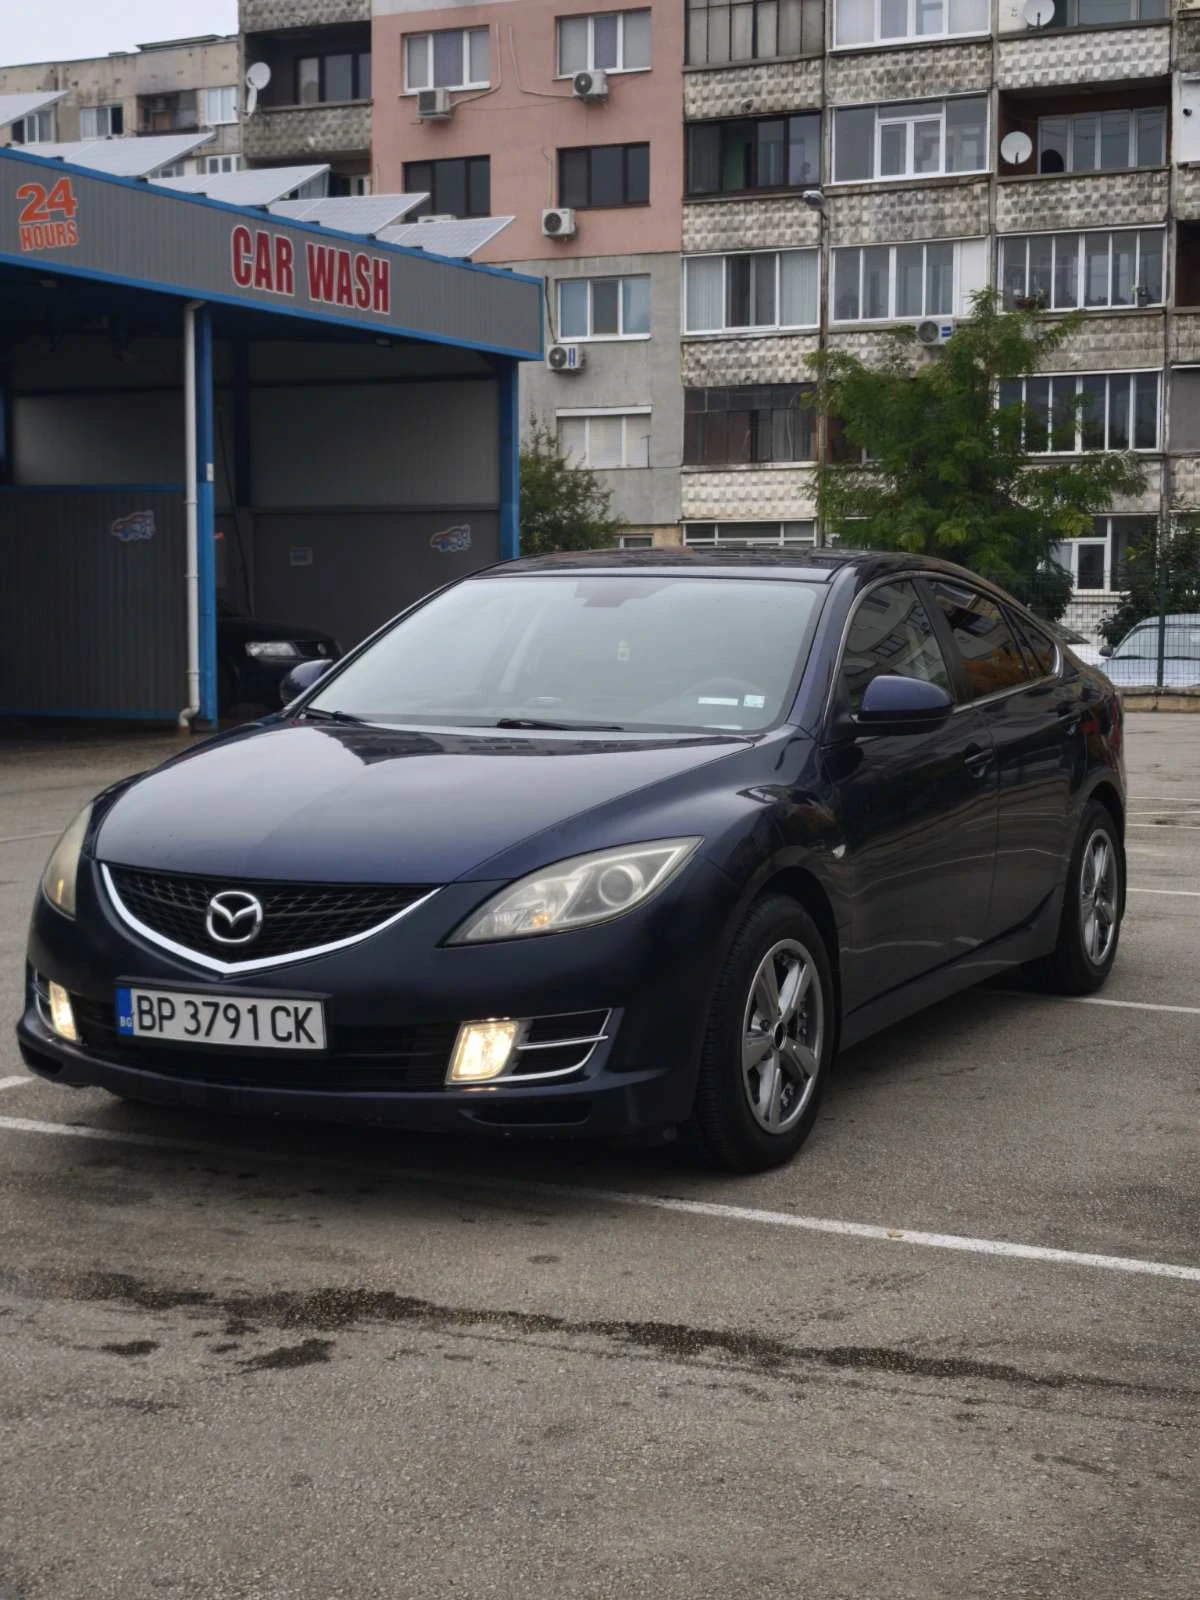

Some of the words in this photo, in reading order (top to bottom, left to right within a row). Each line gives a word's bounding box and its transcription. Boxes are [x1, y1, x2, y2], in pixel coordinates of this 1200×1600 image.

[16, 176, 78, 224] 24
[19, 219, 78, 251] HOURS
[229, 223, 295, 297] CAR
[305, 241, 391, 315] WASH
